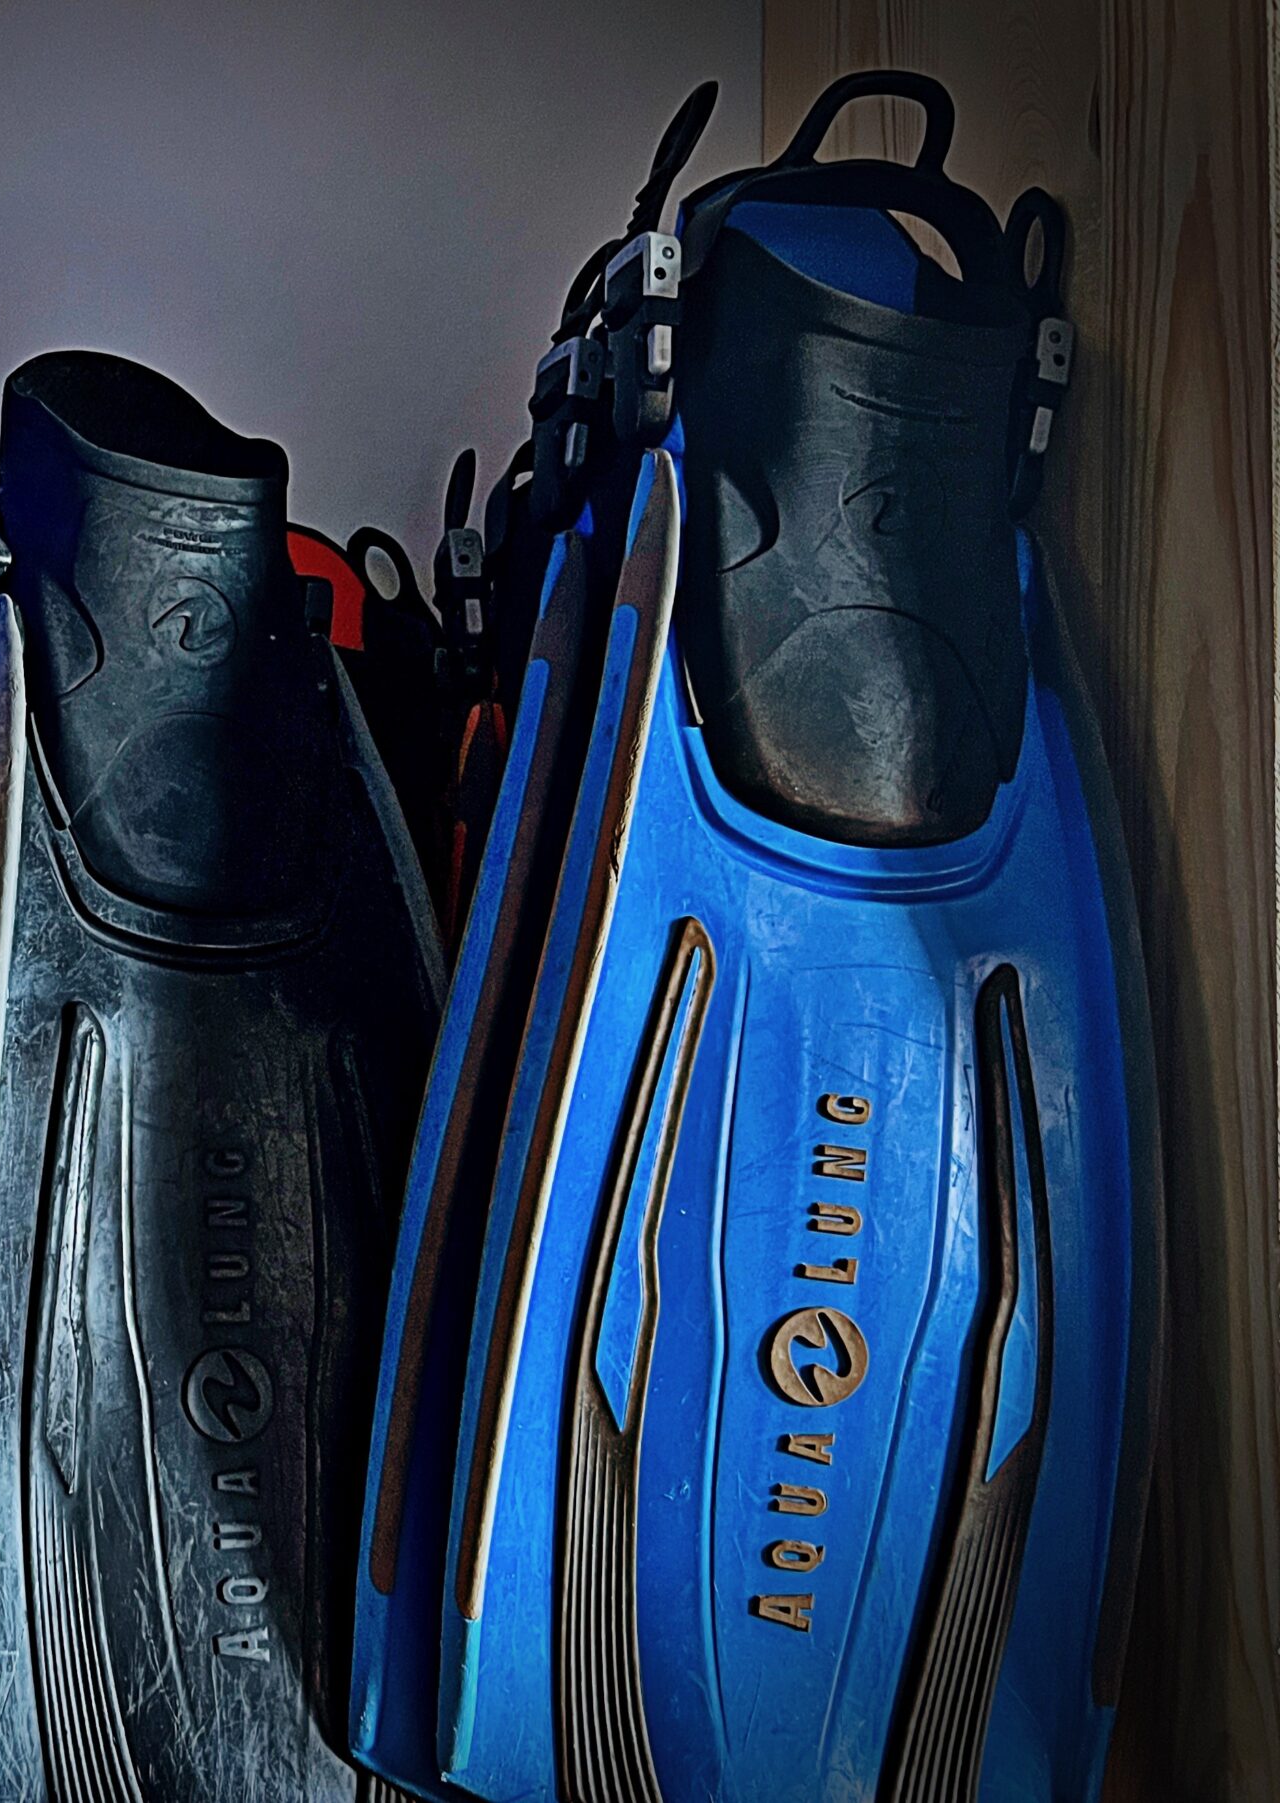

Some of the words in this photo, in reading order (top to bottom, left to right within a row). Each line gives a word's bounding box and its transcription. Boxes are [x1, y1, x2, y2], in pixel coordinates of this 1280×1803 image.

[203, 1146, 251, 1325] LUNG
[749, 1433, 835, 1631] AQUA
[794, 1092, 872, 1284] LUNG
[214, 1468, 270, 1663] AQUA
